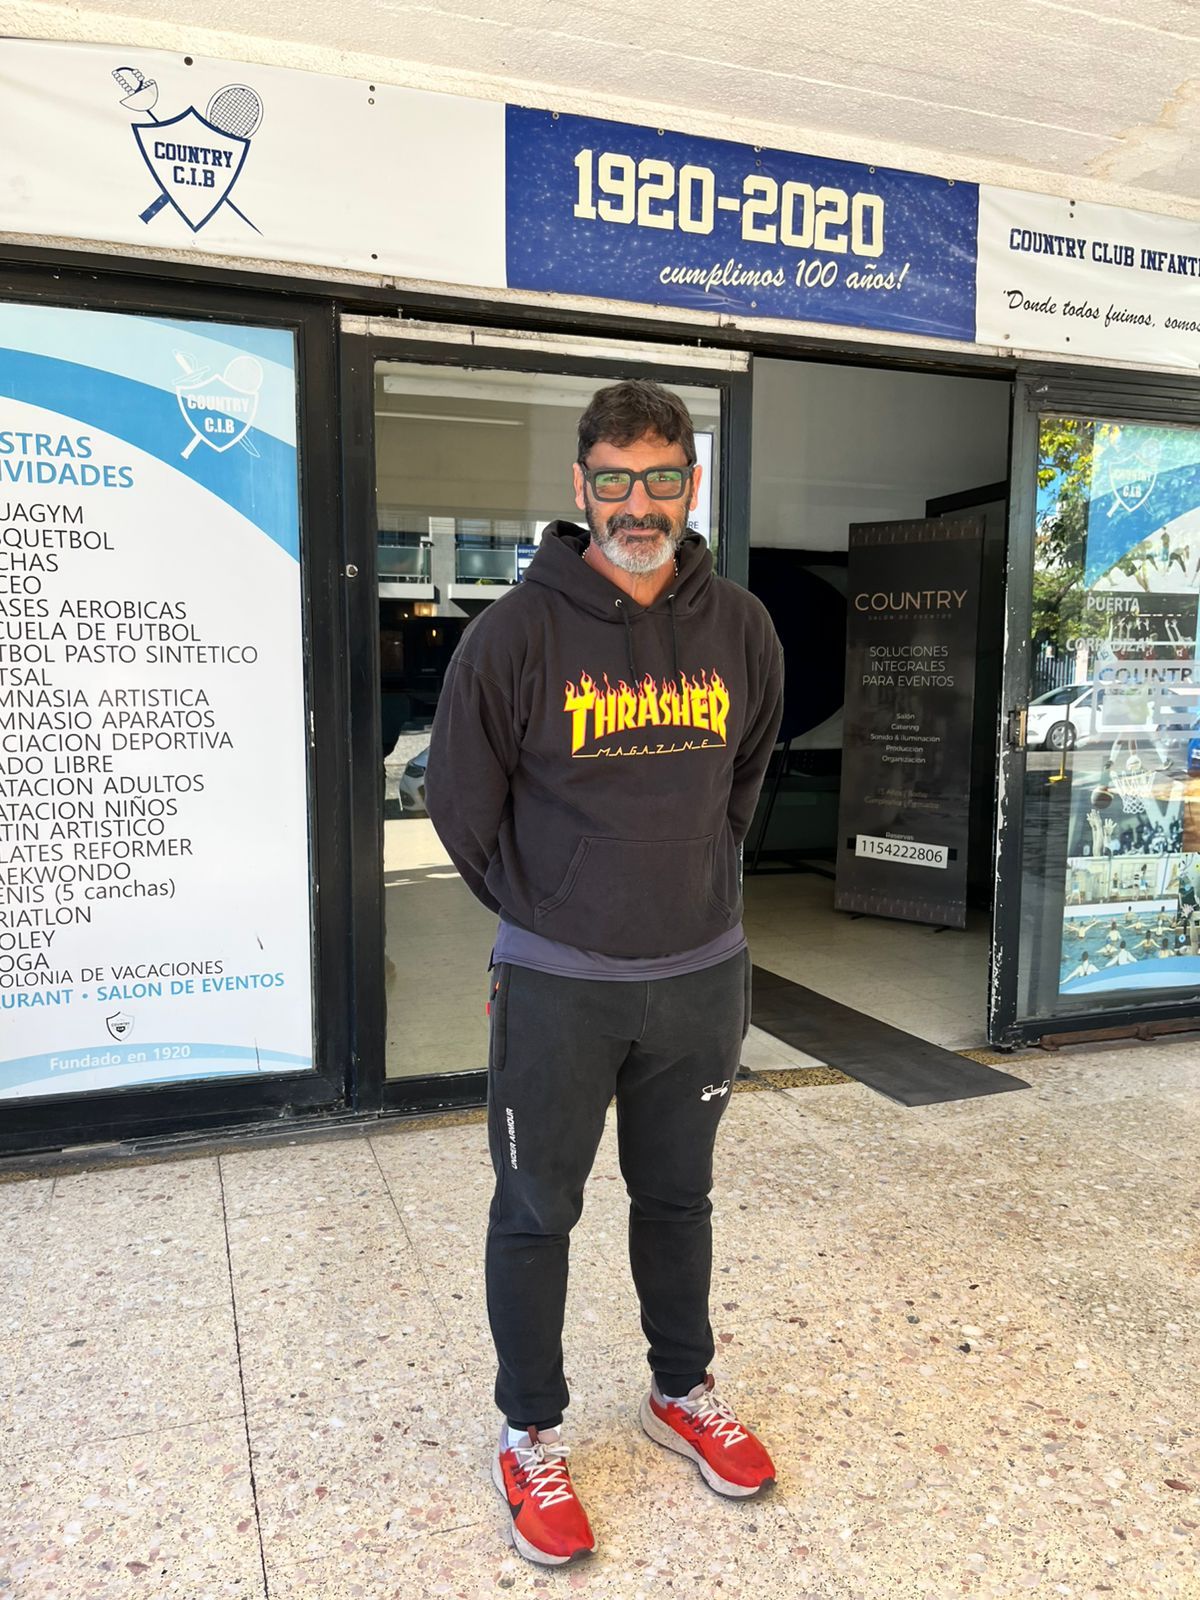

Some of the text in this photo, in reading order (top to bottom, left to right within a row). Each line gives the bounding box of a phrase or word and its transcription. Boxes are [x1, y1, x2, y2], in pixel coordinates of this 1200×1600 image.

[154, 141, 234, 168] COUNTRY
[173, 166, 215, 188] C.I.B
[574, 148, 885, 258] 1920-2020
[1009, 228, 1086, 260] COUNTRY
[1092, 241, 1135, 268] CLUB
[659, 258, 910, 292] cumplimos 100 años!
[1063, 300, 1100, 319] todos
[186, 394, 249, 413] COUNTRY
[204, 417, 235, 434] C.I.B
[0, 431, 92, 459] STRAS
[0, 528, 115, 550] QUETBOL
[0, 551, 58, 572] CHAS
[60, 600, 187, 620] AEROBICAS
[854, 589, 968, 611] COUNTRY
[1086, 596, 1140, 613] PUERTA
[77, 622, 106, 641] DE
[117, 623, 201, 642] FUTBOL
[65, 645, 136, 663] PASTO
[146, 646, 258, 664] SINTETICO
[869, 646, 949, 657] SOLUCIONES
[1065, 637, 1146, 653] CORRDIZA
[871, 660, 946, 672] INTEGRALES
[0, 668, 53, 686] TSAL
[862, 675, 955, 687] PARA EVENTOS
[0, 689, 209, 708] MNASIA ARTISTICA
[0, 710, 215, 730] MNASIO APARATOS
[564, 668, 730, 755] THRASHER
[2, 732, 234, 753] CIACION DEPORTIVA
[597, 738, 710, 757] MAGAZINE
[55, 755, 114, 774] LIBRE
[103, 774, 205, 794] ADULTOS
[105, 795, 178, 817] NIÑOS
[0, 818, 165, 841] TIN ARTISTICO
[74, 839, 193, 860] REFORMER
[861, 839, 943, 863] 1154222806
[55, 884, 74, 905] (5
[85, 879, 176, 900] canchas)
[0, 906, 91, 928] RIATLON
[0, 930, 55, 950] OLEY
[0, 953, 49, 972] OGA
[0, 960, 223, 988] OLONIA DE VACACIONES
[0, 972, 284, 1009] URANT SALON DE EVENTOS
[50, 1045, 191, 1071] Fundado en 1920
